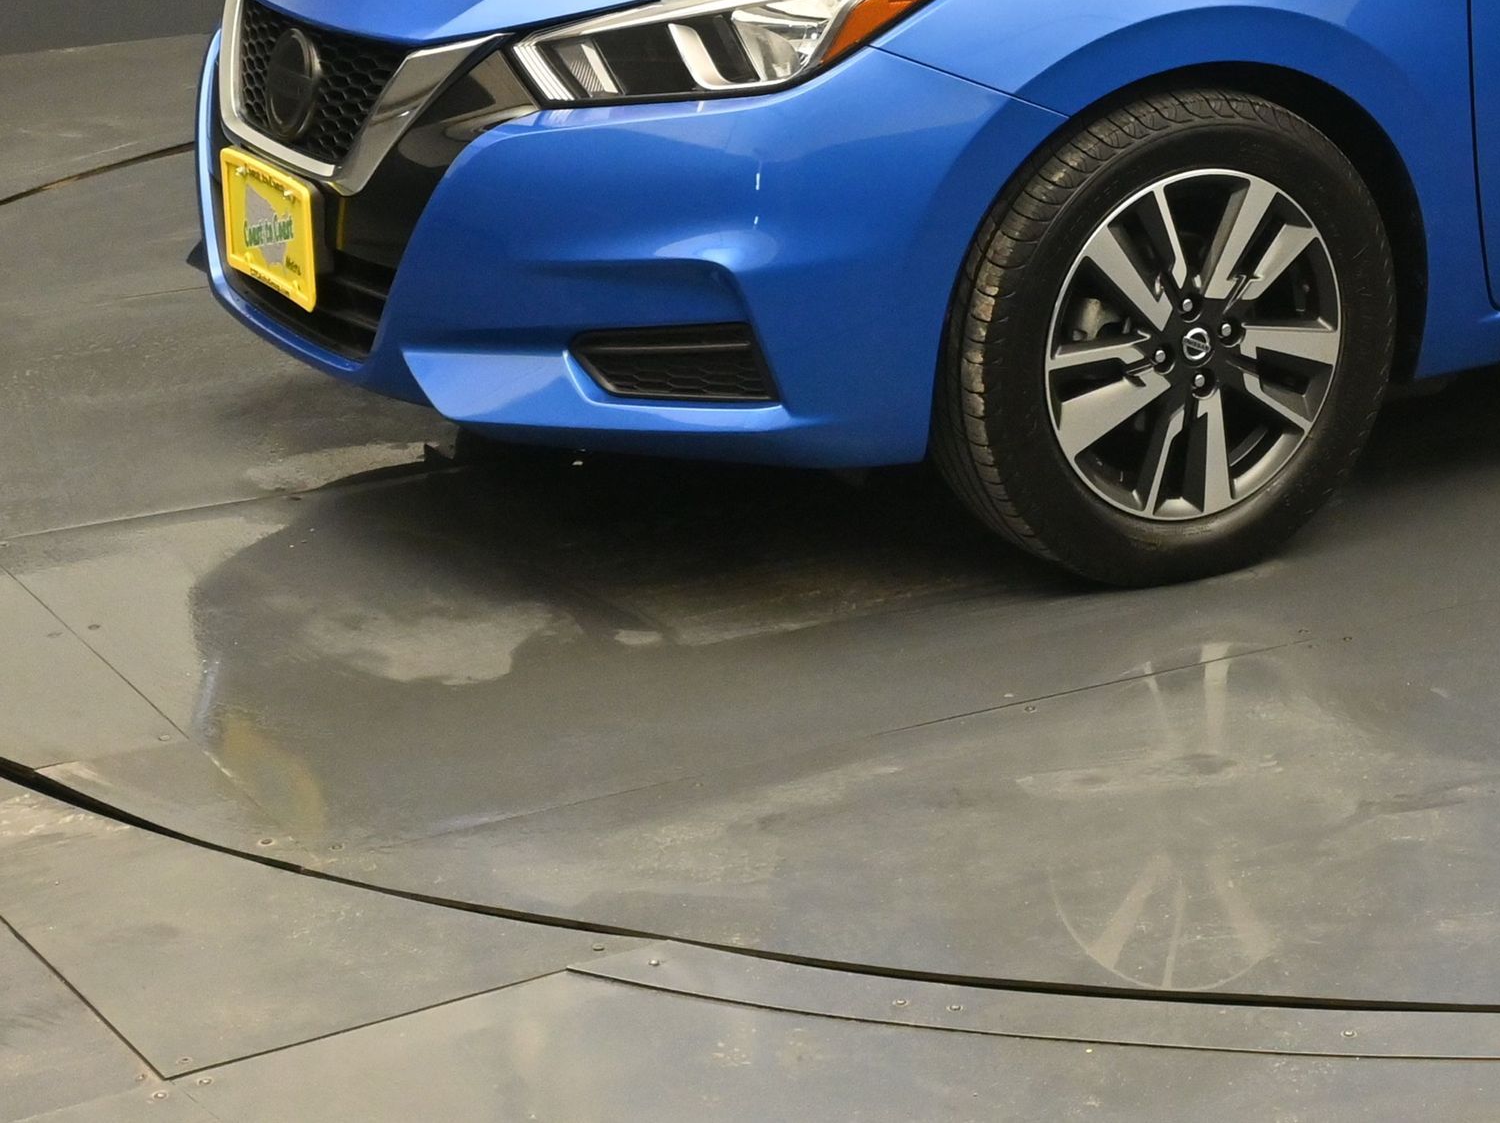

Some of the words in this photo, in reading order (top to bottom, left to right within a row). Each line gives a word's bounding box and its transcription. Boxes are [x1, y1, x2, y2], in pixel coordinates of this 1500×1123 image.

[244, 220, 263, 247] Coast
[273, 215, 294, 241] Coast
[1184, 339, 1209, 351] NISSAN
